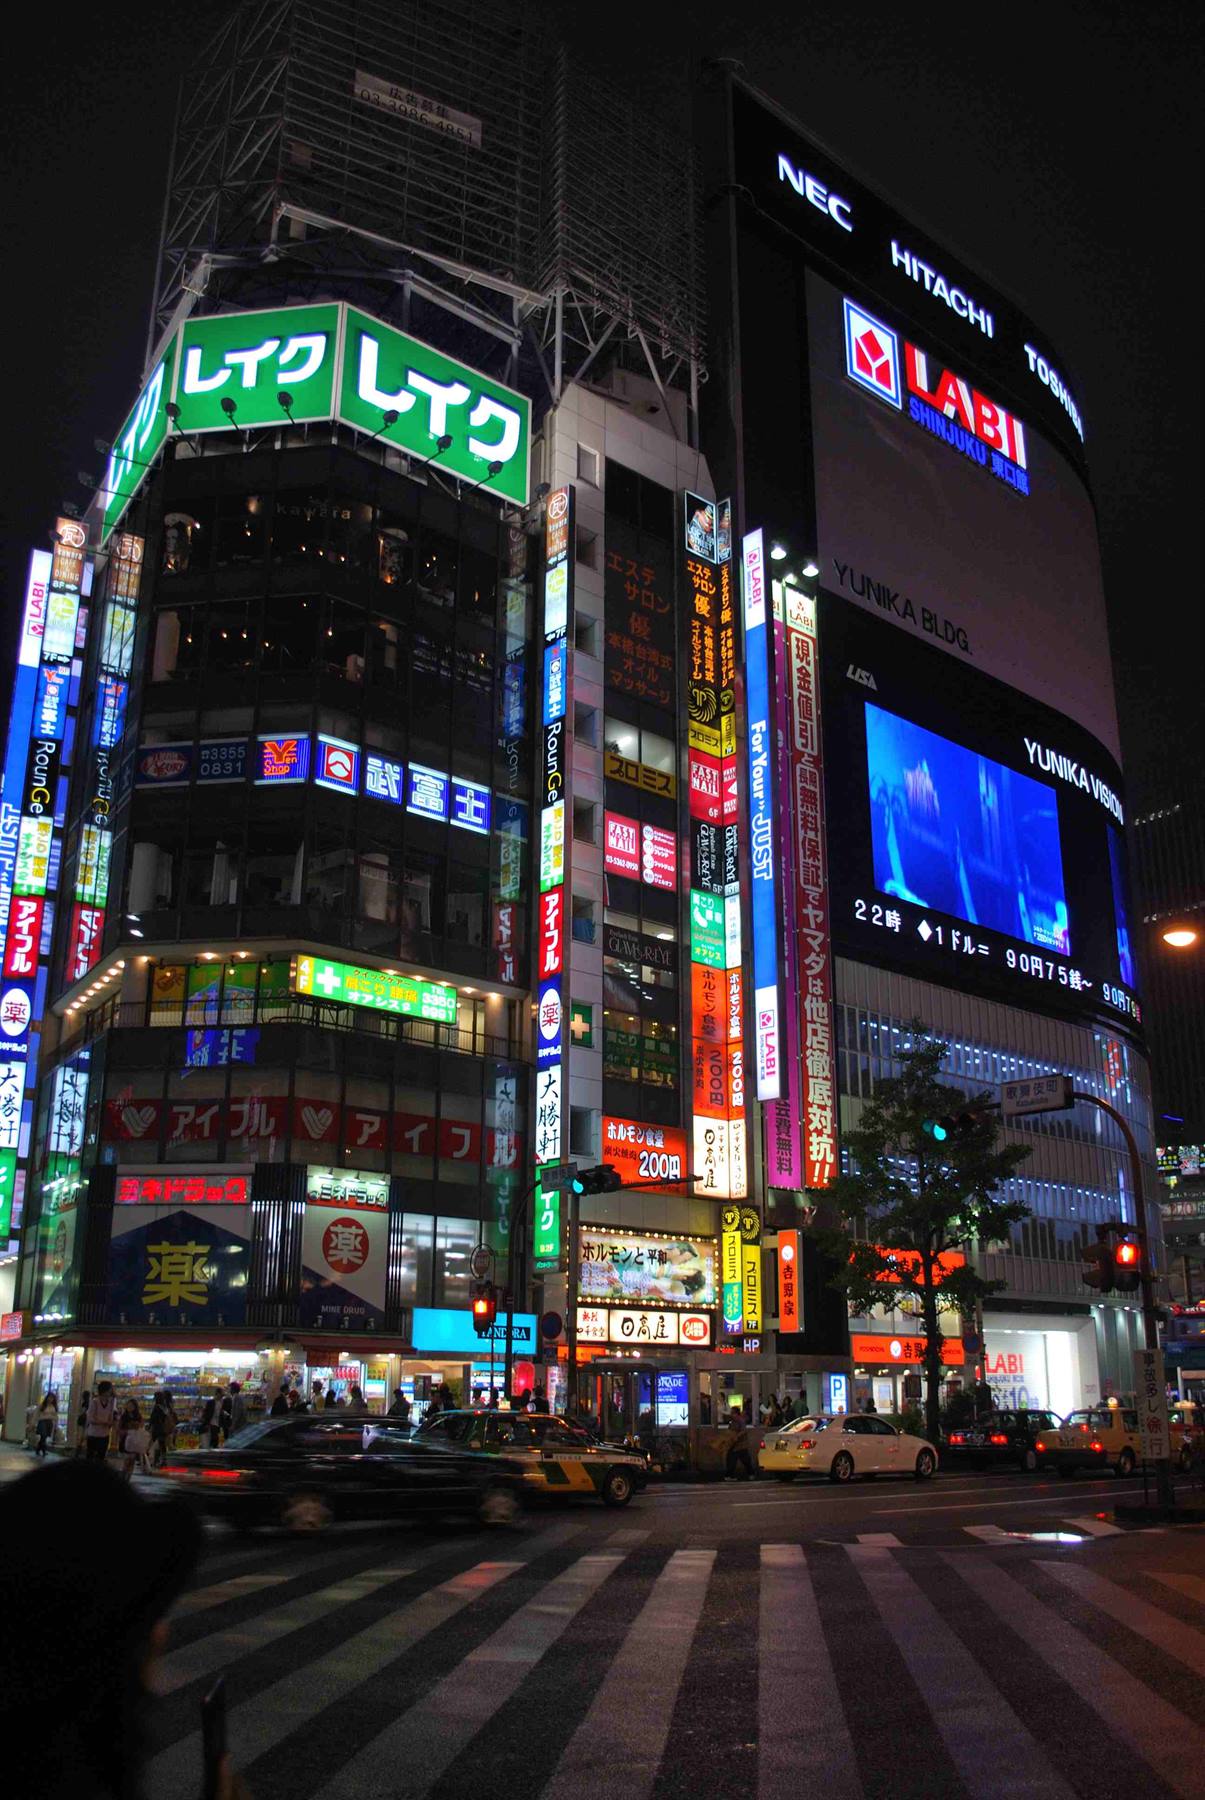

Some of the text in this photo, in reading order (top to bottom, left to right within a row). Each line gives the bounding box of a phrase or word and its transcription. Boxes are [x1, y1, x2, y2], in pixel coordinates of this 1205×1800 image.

[778, 154, 853, 232] NEC
[891, 239, 994, 339] HITACHI
[184, 332, 328, 394] レイク
[357, 331, 521, 464] レイク
[904, 341, 1027, 471] LABI
[908, 395, 987, 465] SHINJUKU
[687, 560, 713, 579] エステ
[692, 575, 716, 595] サロン
[752, 566, 762, 605] LABI
[30, 582, 46, 619] LABI
[624, 579, 672, 615] サロン
[694, 593, 712, 618] 優
[833, 559, 973, 656] YUNIKA BLDG.
[555, 627, 567, 639] 7F
[789, 608, 814, 628] LABI
[43, 652, 58, 662] 7F
[690, 729, 720, 748] プロミス
[30, 740, 56, 815] RounGe
[200, 760, 242, 776] 0831
[263, 761, 291, 777] Shop
[547, 720, 562, 803] RounGe
[609, 755, 672, 795] プロミス
[691, 761, 719, 782] FAST
[365, 756, 487, 825] 武富士
[691, 777, 720, 798] NAIL
[1023, 736, 1124, 826] YUNIKA VISION
[708, 807, 719, 818] 6F
[751, 719, 773, 881] For Your JUST
[608, 820, 636, 841] FAST
[608, 836, 636, 855] NAIL
[712, 882, 723, 894] 5F
[544, 892, 560, 973] アイフル
[855, 899, 902, 933] 22時
[11, 900, 38, 973] アイフル
[694, 946, 722, 961] オアシス
[3, 1001, 28, 1025] 薬
[541, 1001, 560, 1028] 薬
[729, 972, 742, 1039] ホルモン食堂
[765, 1031, 776, 1078] LABI
[709, 1050, 725, 1106] 200円
[732, 1052, 744, 1107] 200円
[170, 1102, 276, 1138] アイフル
[538, 1073, 560, 1156] 大勝軒
[608, 1121, 664, 1149] ホルモン食堂
[638, 1149, 681, 1180] 200円
[540, 1190, 556, 1232] イク
[328, 1224, 366, 1265] 薬
[728, 1235, 737, 1280] プロミス
[142, 1240, 211, 1307] 薬
[746, 1260, 757, 1316] プロミス
[321, 1305, 366, 1315] MINE DRUG
[620, 1314, 670, 1340] 日高屋
[747, 1320, 757, 1329] 7F
[727, 1324, 740, 1333] 7F
[743, 1338, 760, 1353] HP
[985, 1353, 1025, 1374] LABI
[833, 1379, 843, 1398] P
